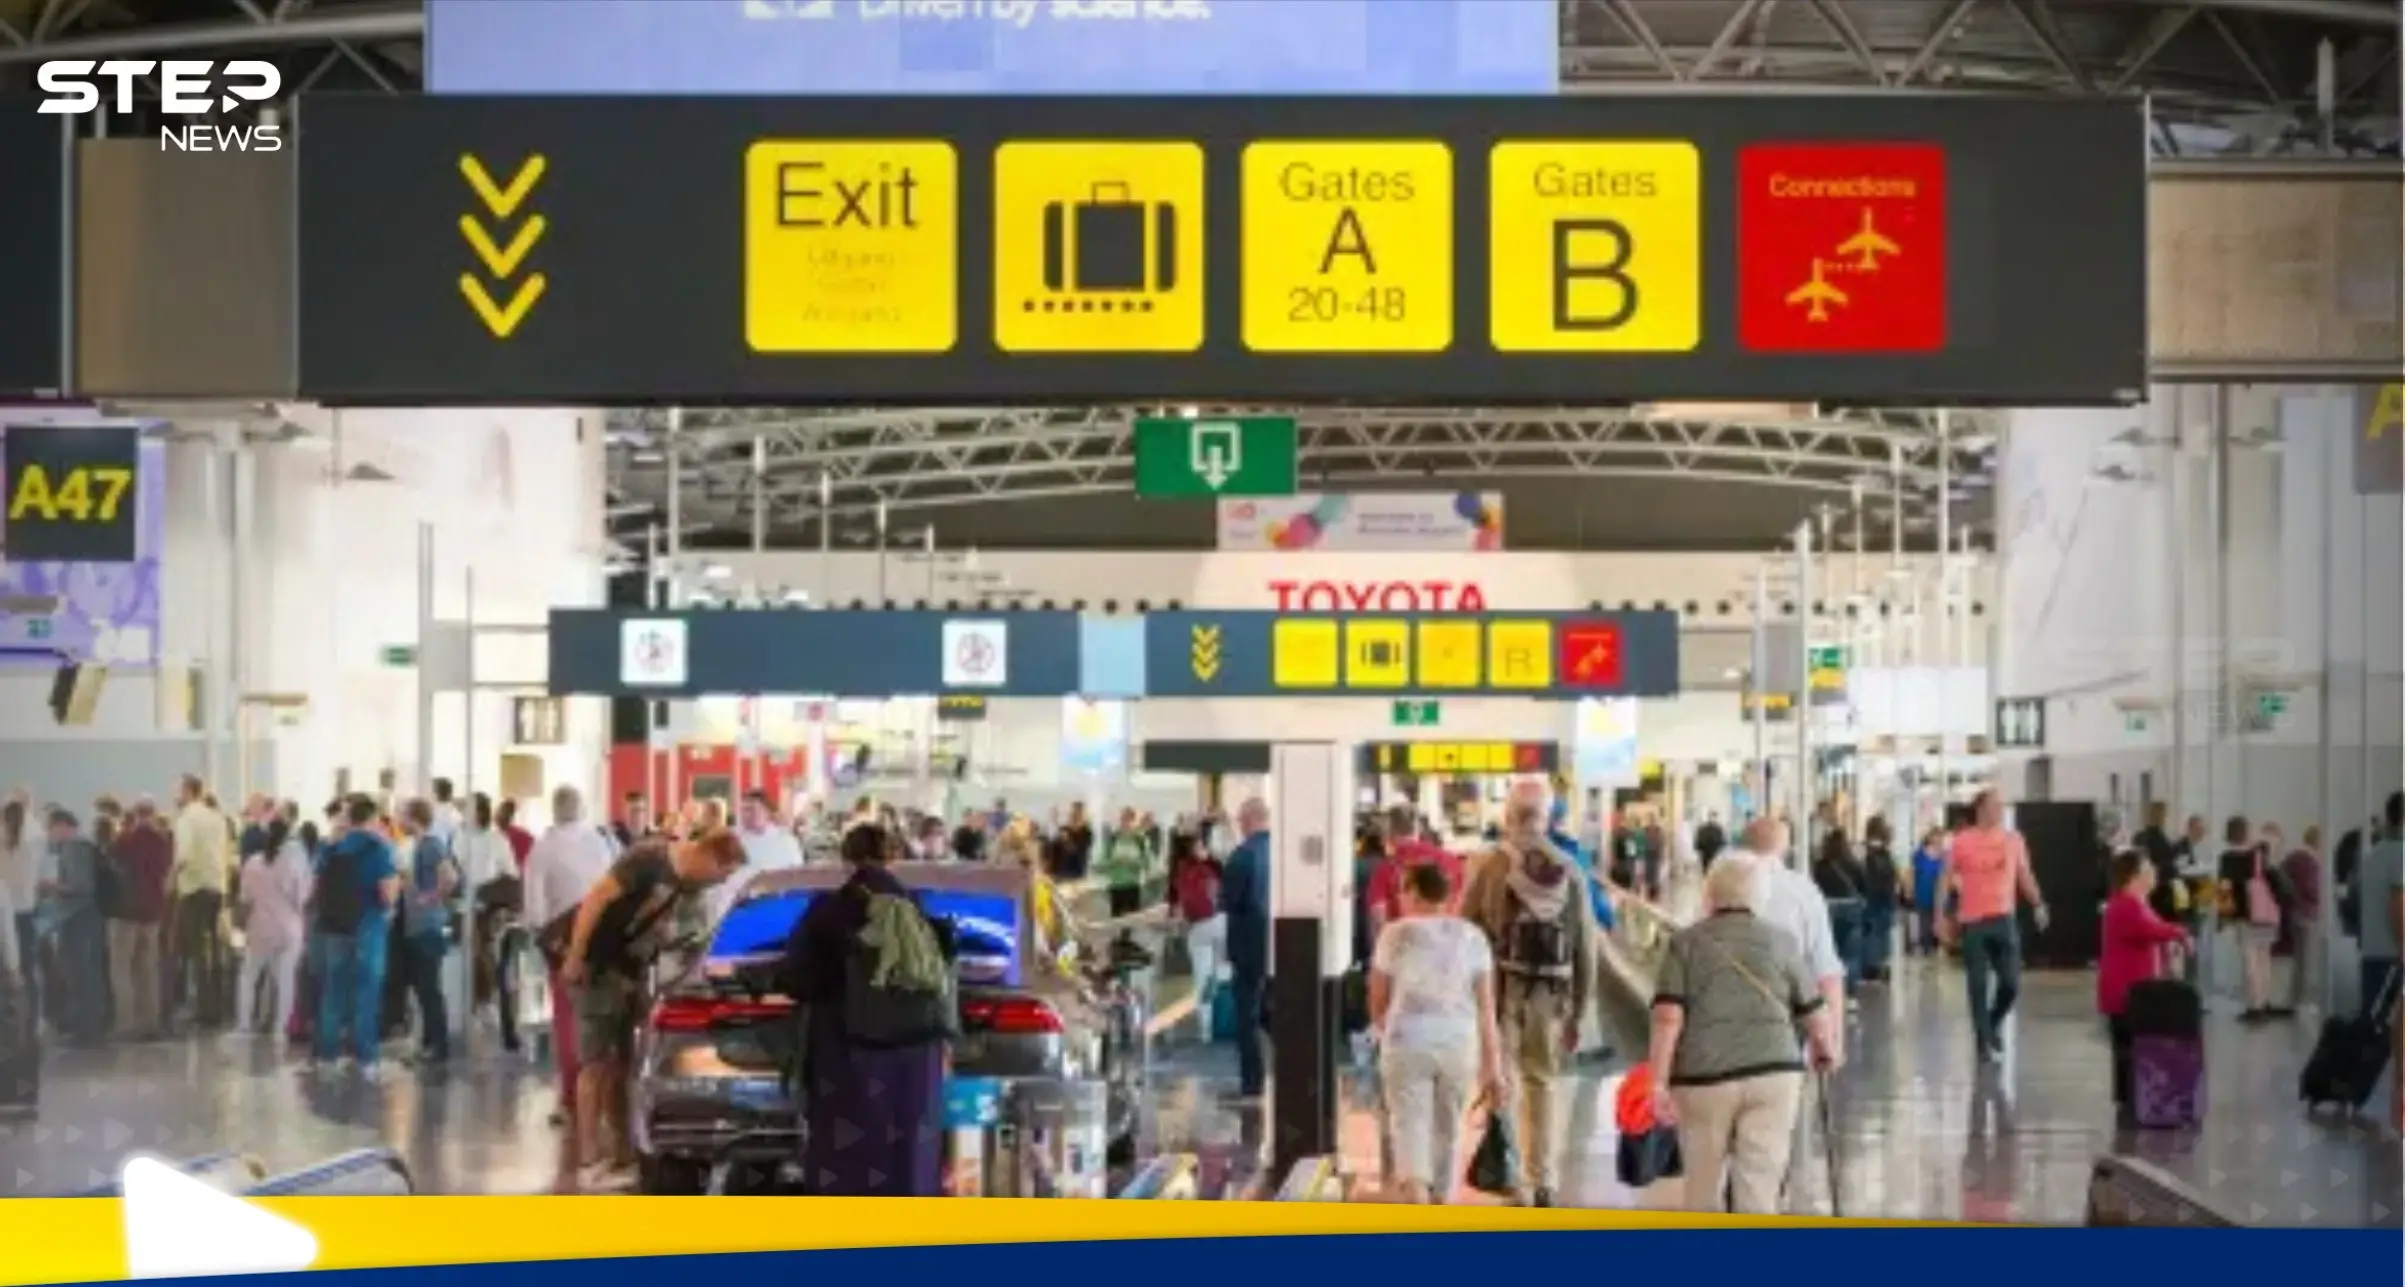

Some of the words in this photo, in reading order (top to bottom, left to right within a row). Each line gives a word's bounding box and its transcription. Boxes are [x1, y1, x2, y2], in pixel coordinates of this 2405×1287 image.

[777, 161, 921, 228] Exit
[1279, 161, 1415, 202] Gates
[1533, 161, 1657, 198] Gates
[1769, 173, 1916, 198] Connections
[1318, 205, 1378, 275] A
[1553, 218, 1638, 332] B
[1286, 285, 1406, 323] 20-48
[9, 464, 131, 521] A47
[1269, 578, 1486, 613] TOYOTA
